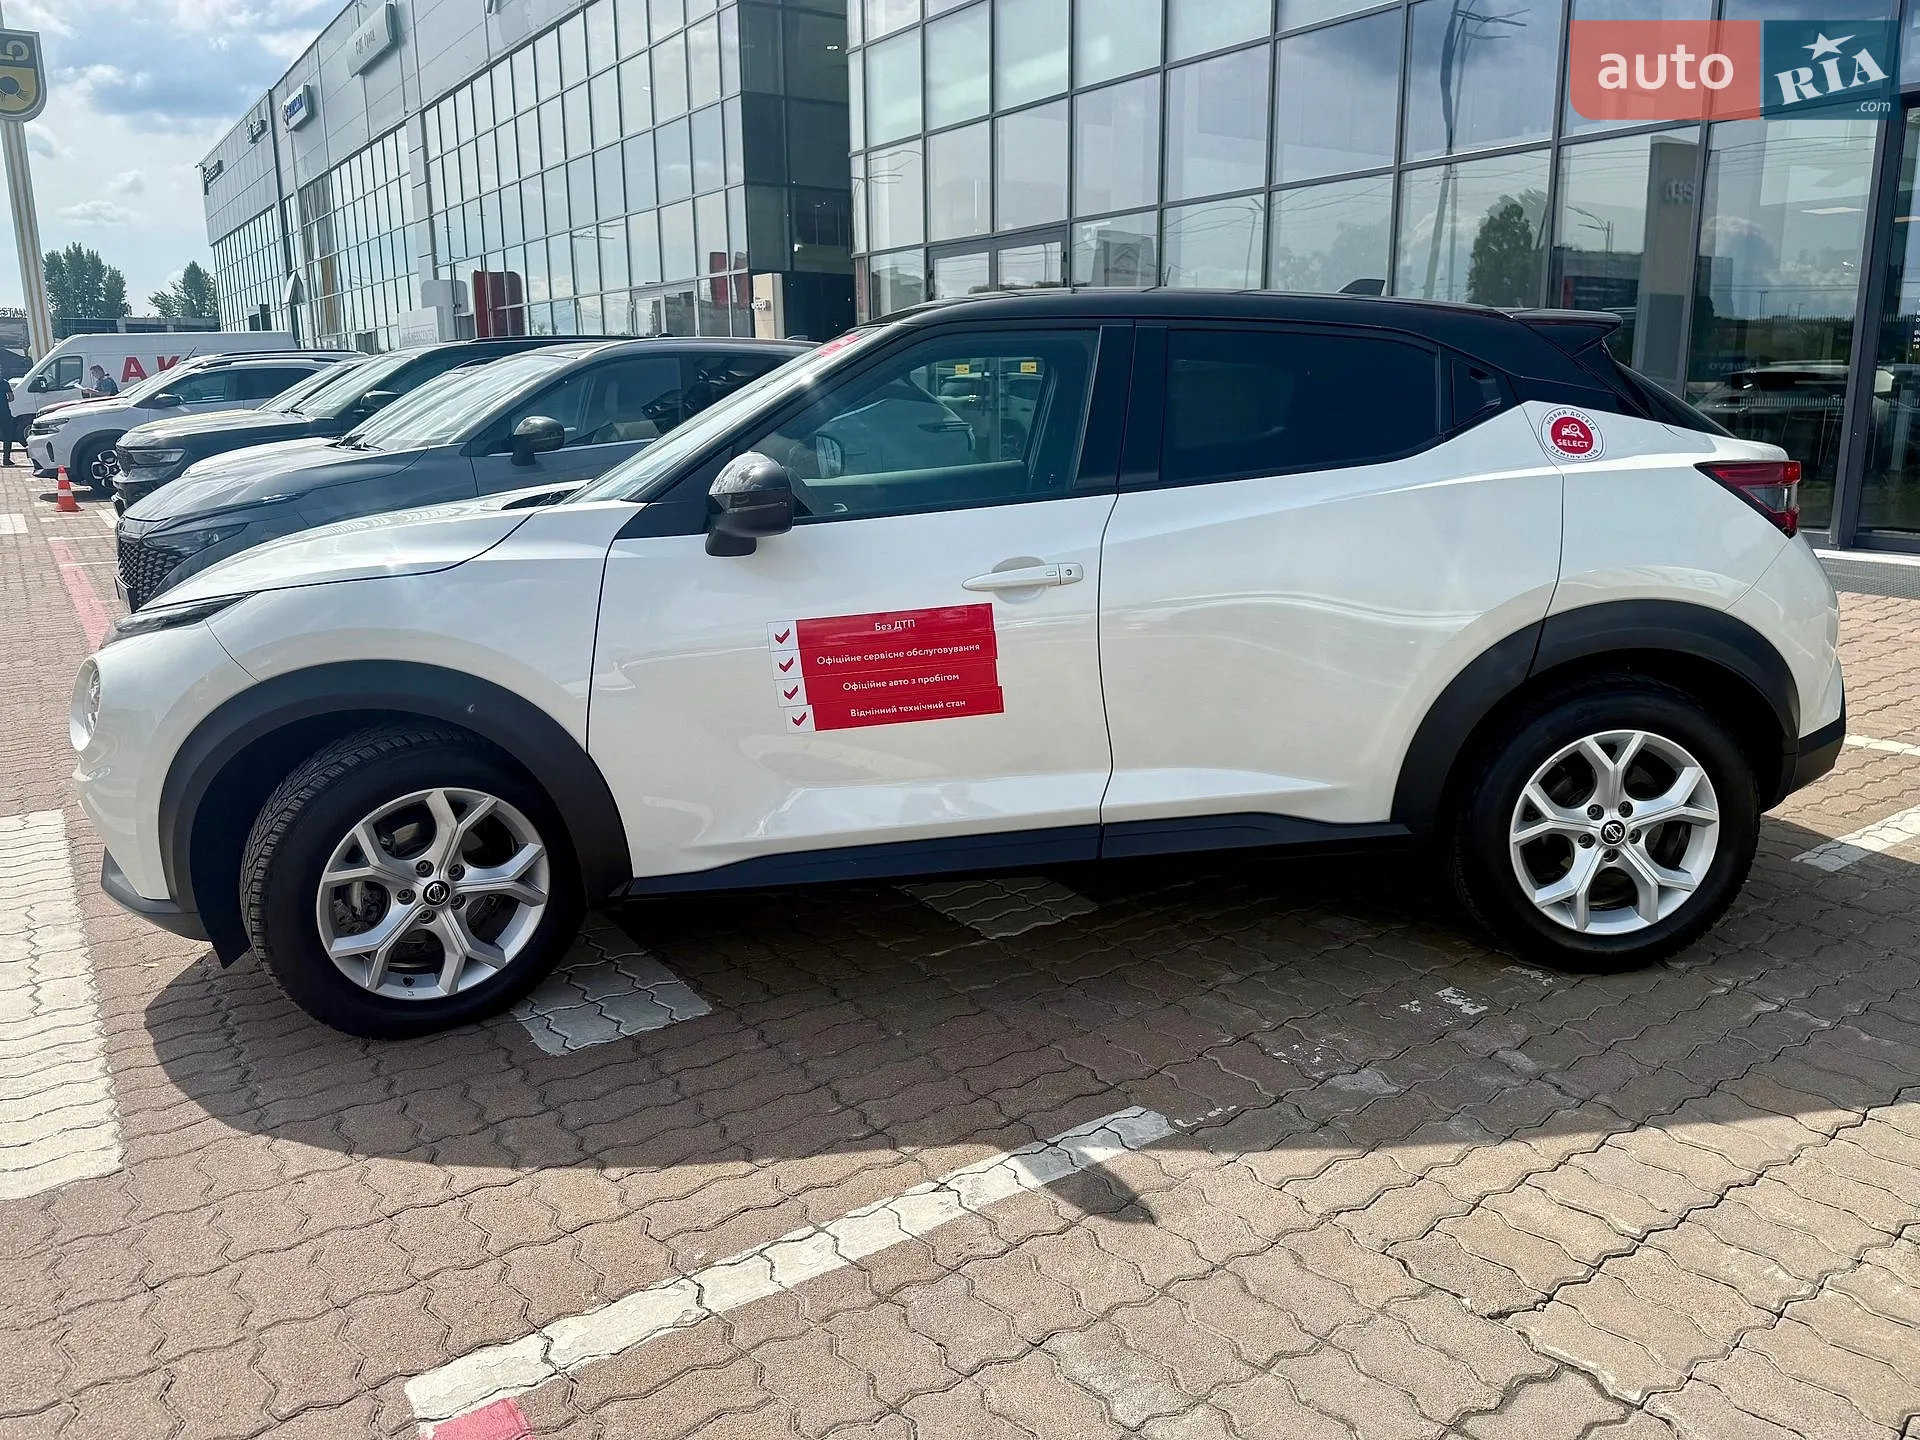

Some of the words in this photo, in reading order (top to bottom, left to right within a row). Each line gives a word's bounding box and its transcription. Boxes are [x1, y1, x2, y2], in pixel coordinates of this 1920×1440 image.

[1557, 439, 1589, 448] SELECT
[874, 622, 892, 631] Без
[893, 619, 916, 631] ДТП
[816, 654, 862, 666] Офіційне
[863, 650, 905, 661] сервісне
[906, 644, 980, 657] обслуговування
[843, 680, 887, 691] Офіційне
[889, 678, 909, 687] авто
[918, 673, 960, 684] пробігом
[850, 704, 898, 717] Відмінний
[899, 701, 944, 712] технічний
[946, 700, 966, 708] стан
